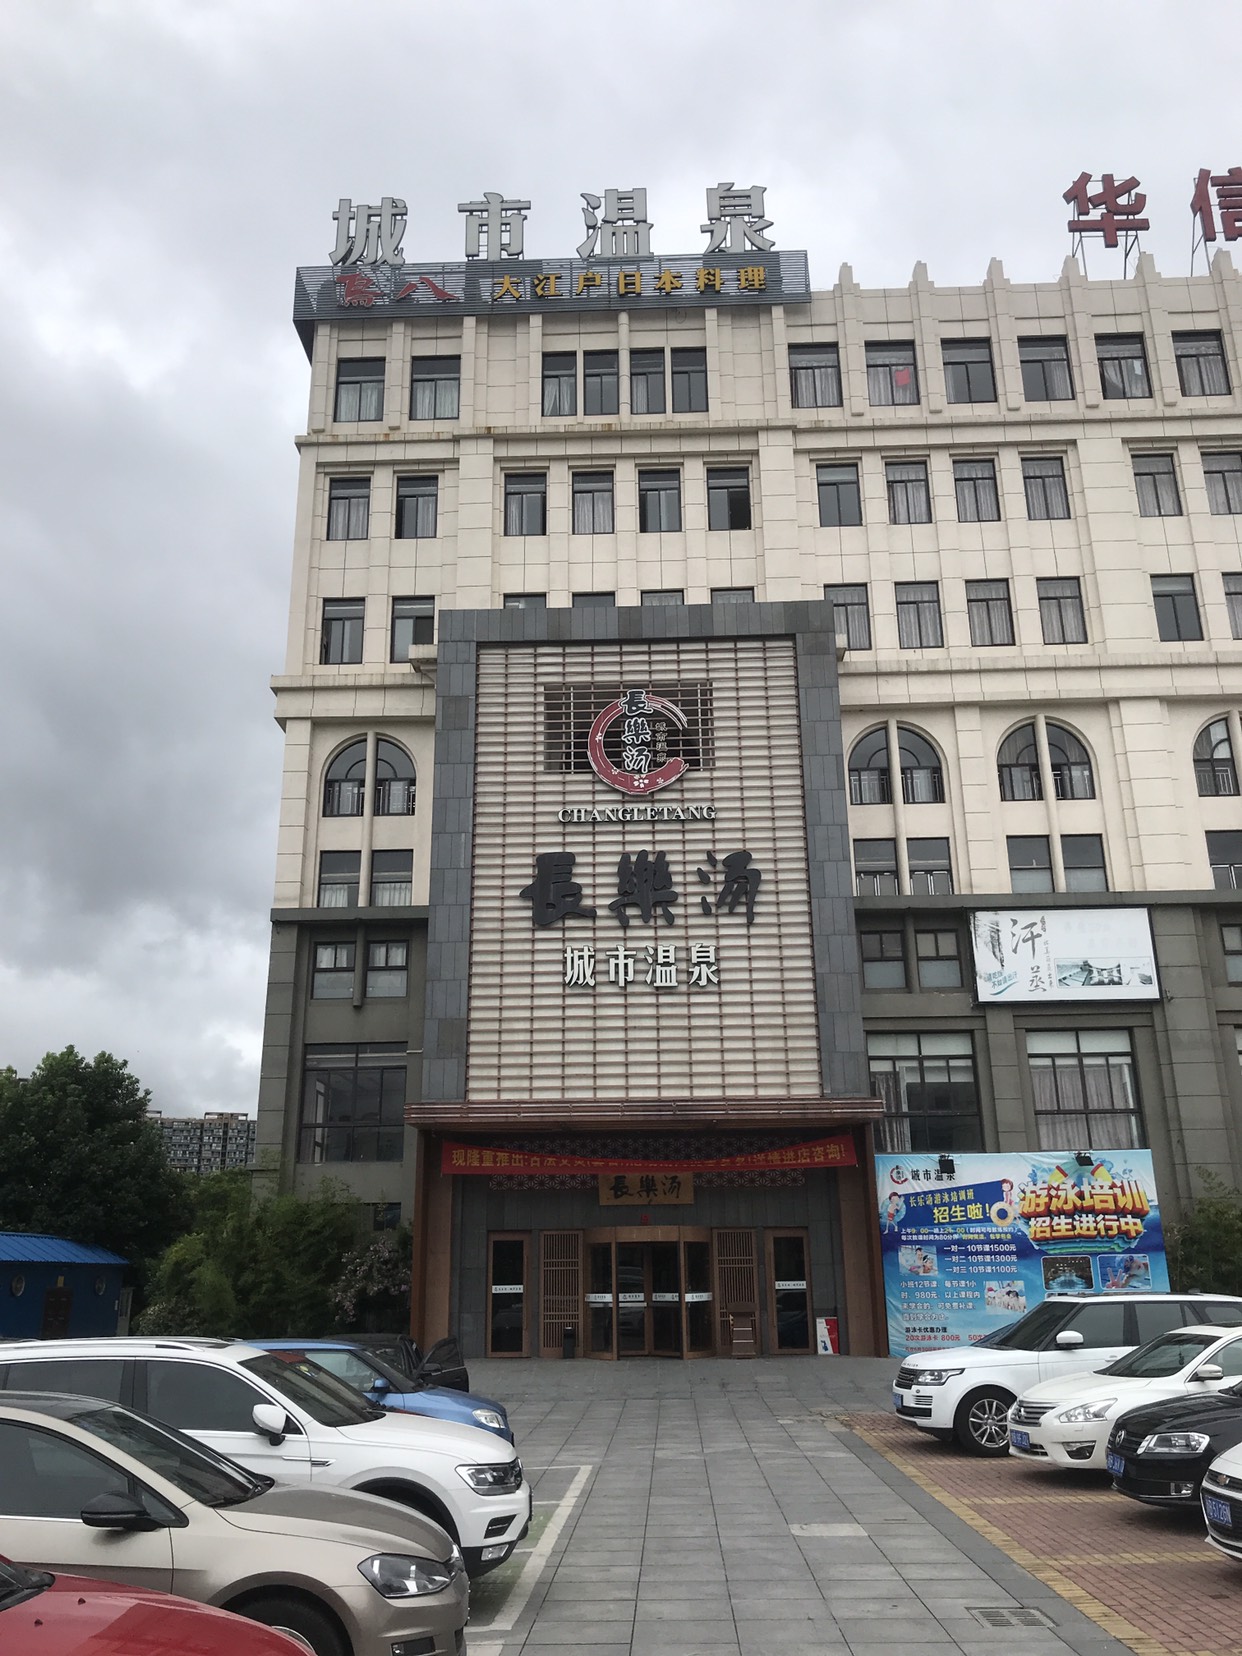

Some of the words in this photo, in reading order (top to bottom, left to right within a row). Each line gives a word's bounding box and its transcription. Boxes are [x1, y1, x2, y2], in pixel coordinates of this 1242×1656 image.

[1062, 166, 1242, 248] 华信
[328, 182, 776, 265] 城市温泉
[493, 266, 767, 300] 大江户日本料理
[557, 805, 718, 823] CHANGLETANG
[563, 943, 720, 988] 城市温泉
[1010, 916, 1048, 993] 汗蒸
[908, 1188, 975, 1208] 长乐汤游泳培训班
[1018, 1179, 1150, 1216] 游泳培训
[932, 1202, 991, 1224] 招生啦!
[1028, 1212, 1145, 1240] 招生进行中
[943, 1244, 965, 1252] 一对一
[967, 1243, 1017, 1252] 10节课1500元
[944, 1255, 966, 1263] 一对二
[968, 1254, 1018, 1263] 10节课1300元
[945, 1266, 967, 1274] 一对三
[969, 1265, 1018, 1274] 10节课1100元
[905, 1334, 939, 1342] 20次游泳卡
